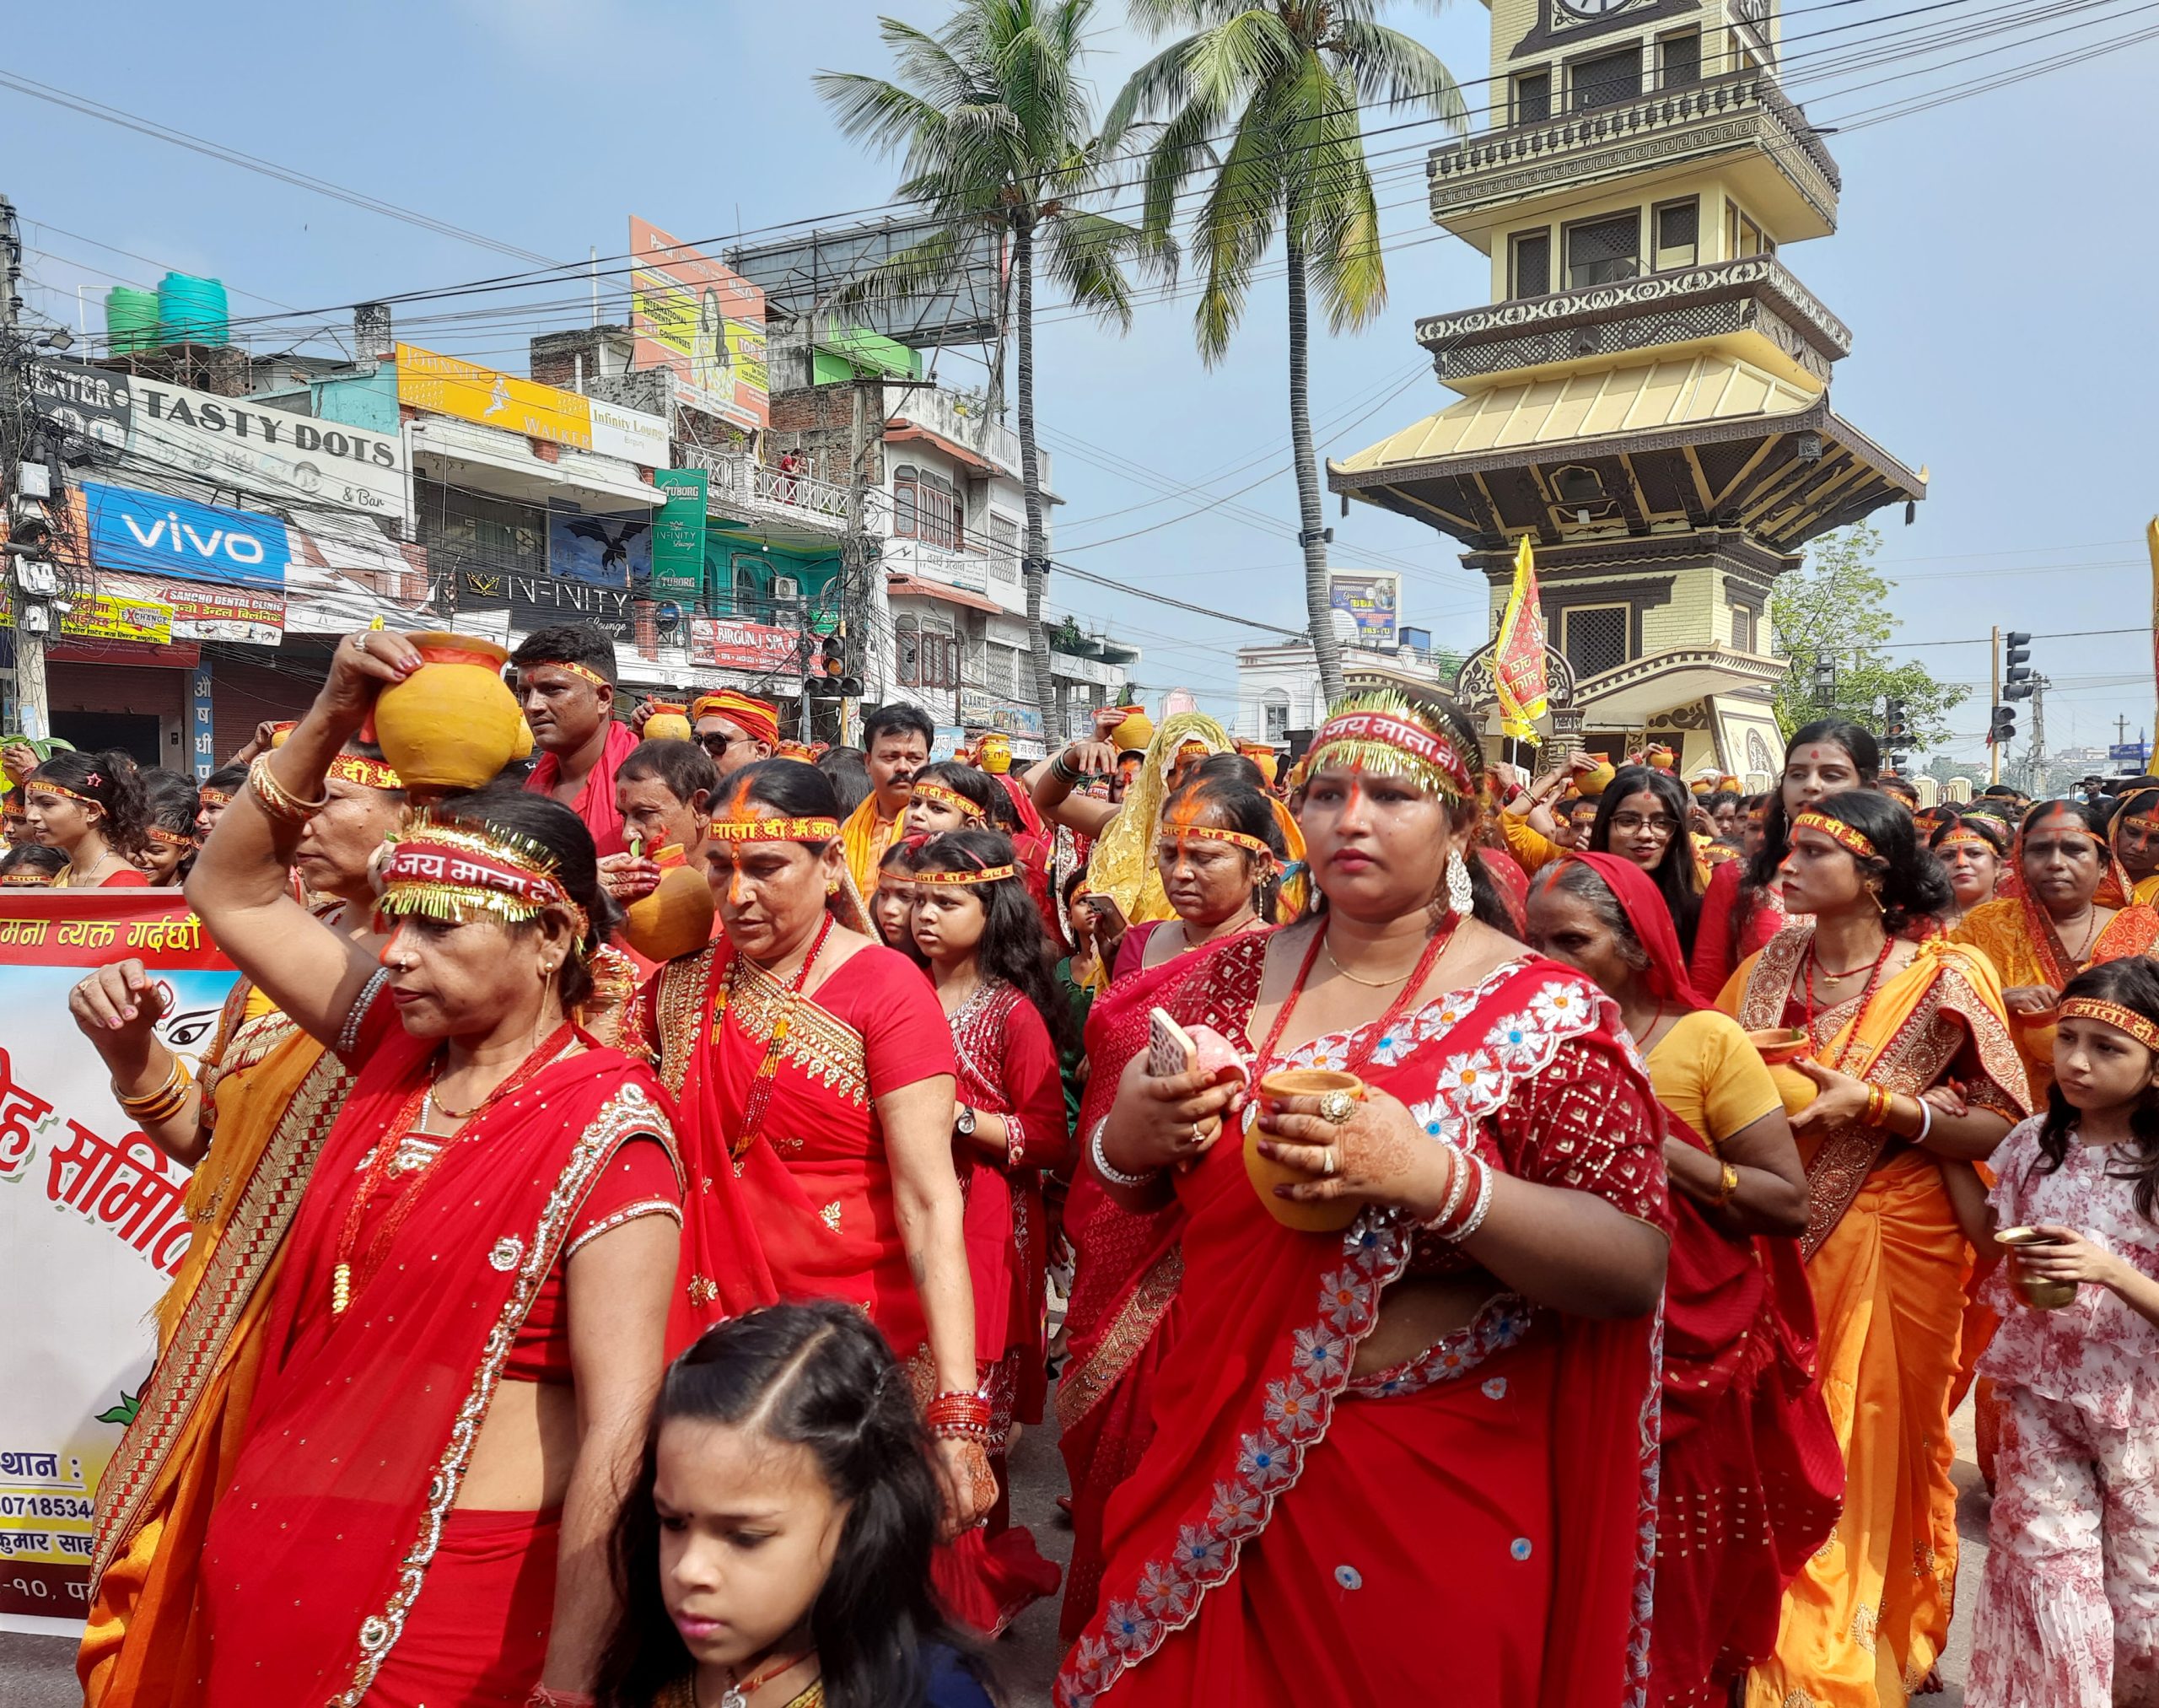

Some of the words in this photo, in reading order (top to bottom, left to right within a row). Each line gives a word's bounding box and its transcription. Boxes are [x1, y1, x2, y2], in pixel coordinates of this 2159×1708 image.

[643, 298, 686, 325] INTERNATIONAL
[643, 306, 672, 326] STUDENTS
[660, 329, 691, 349] COUNTRIES
[740, 339, 756, 355] TOP
[140, 388, 283, 444] TASTY
[295, 424, 395, 468] DOTS
[524, 416, 590, 446] WALKER
[593, 409, 632, 432] Infinity
[357, 489, 385, 508] Bar
[665, 486, 699, 497] TUBORG
[121, 511, 264, 563] vivo
[660, 577, 695, 588] TUBORG
[170, 590, 213, 604] SANCHO
[214, 595, 250, 608] DENTAL
[252, 600, 283, 612] CLINIC
[508, 574, 627, 617] INFINITY
[121, 607, 169, 625] EXCHANGE
[717, 627, 762, 649] BIRGUNJ
[766, 633, 786, 653] SPA
[1325, 716, 1372, 735] जय
[1373, 717, 1438, 757] माता
[342, 760, 372, 785] दी
[712, 822, 758, 839] माता
[762, 818, 787, 838] दी
[812, 822, 833, 838] जय
[397, 853, 446, 879] जय
[450, 859, 527, 895] माता
[0, 919, 51, 946] मना
[57, 920, 121, 948] व्यक्त
[2075, 1002, 2127, 1026] माता
[2133, 1020, 2154, 1040] दी
[0, 1452, 57, 1478] थान
[0, 1496, 94, 1518] 0718534
